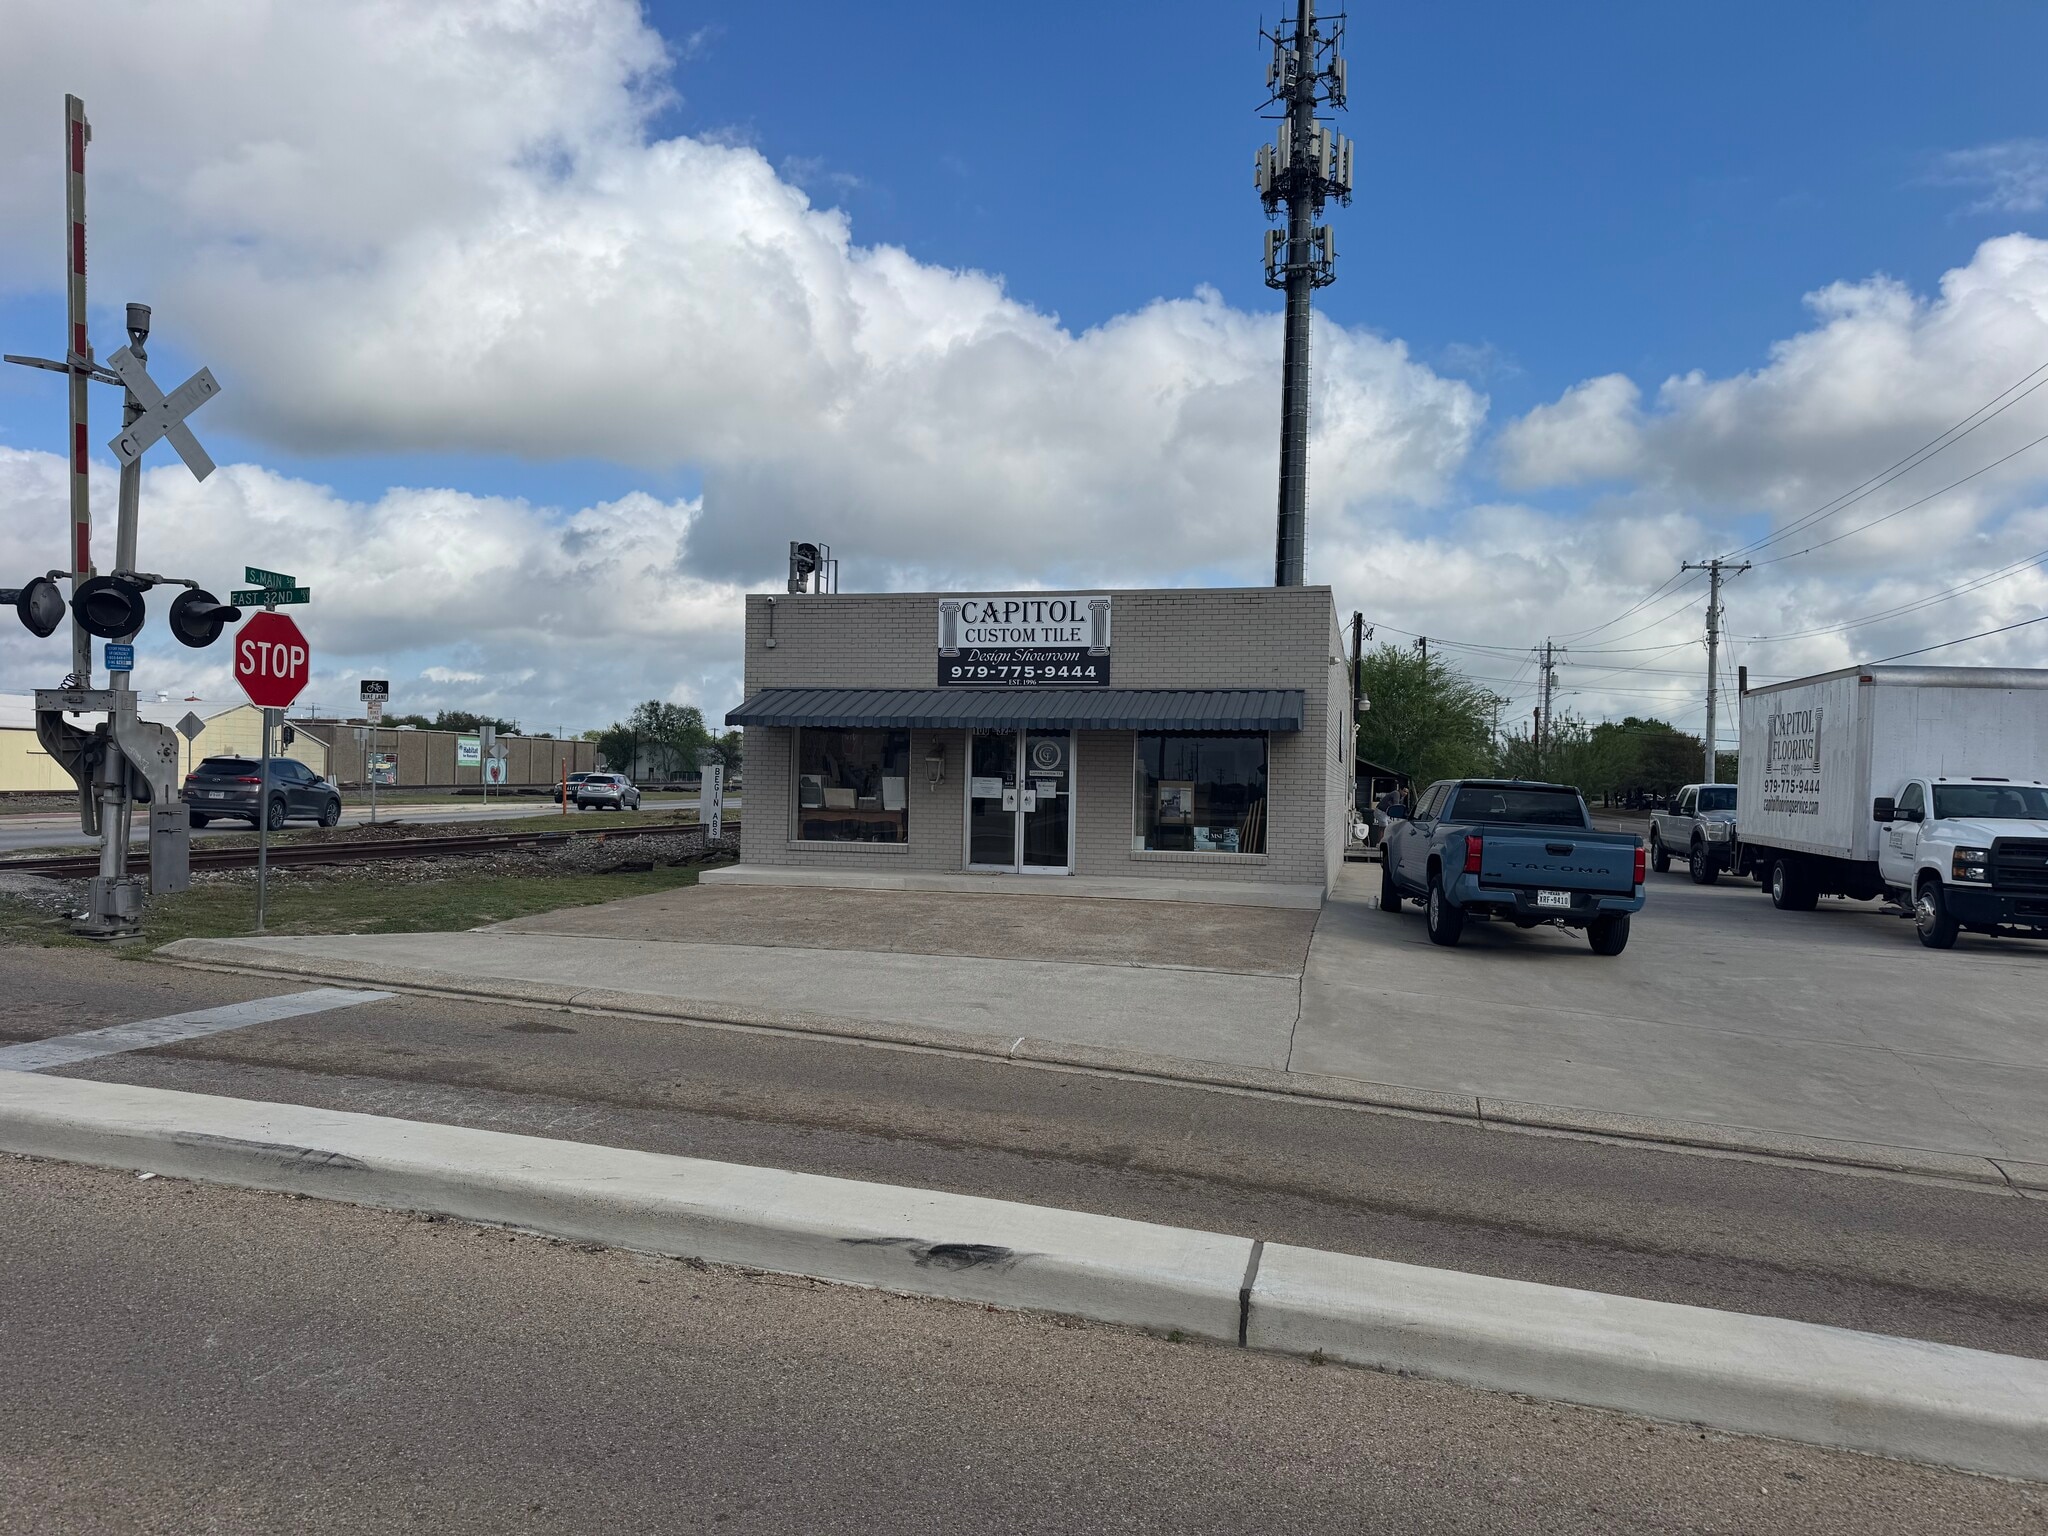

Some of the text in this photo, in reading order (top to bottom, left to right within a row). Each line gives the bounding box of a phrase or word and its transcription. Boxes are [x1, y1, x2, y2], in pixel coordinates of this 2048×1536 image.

[231, 591, 293, 605] EAST 32ND
[961, 600, 1087, 624] CAPITOL
[965, 627, 1082, 643] CUSTOM TILE
[240, 639, 305, 679] STOP
[967, 648, 1080, 665] Design Showroom
[951, 665, 1097, 678] 979-775-9444
[1774, 709, 1815, 737] CAPITOL
[1772, 738, 1814, 760] FLOORING
[713, 767, 721, 807] BEGIN
[1507, 862, 1610, 875] TACOMA
